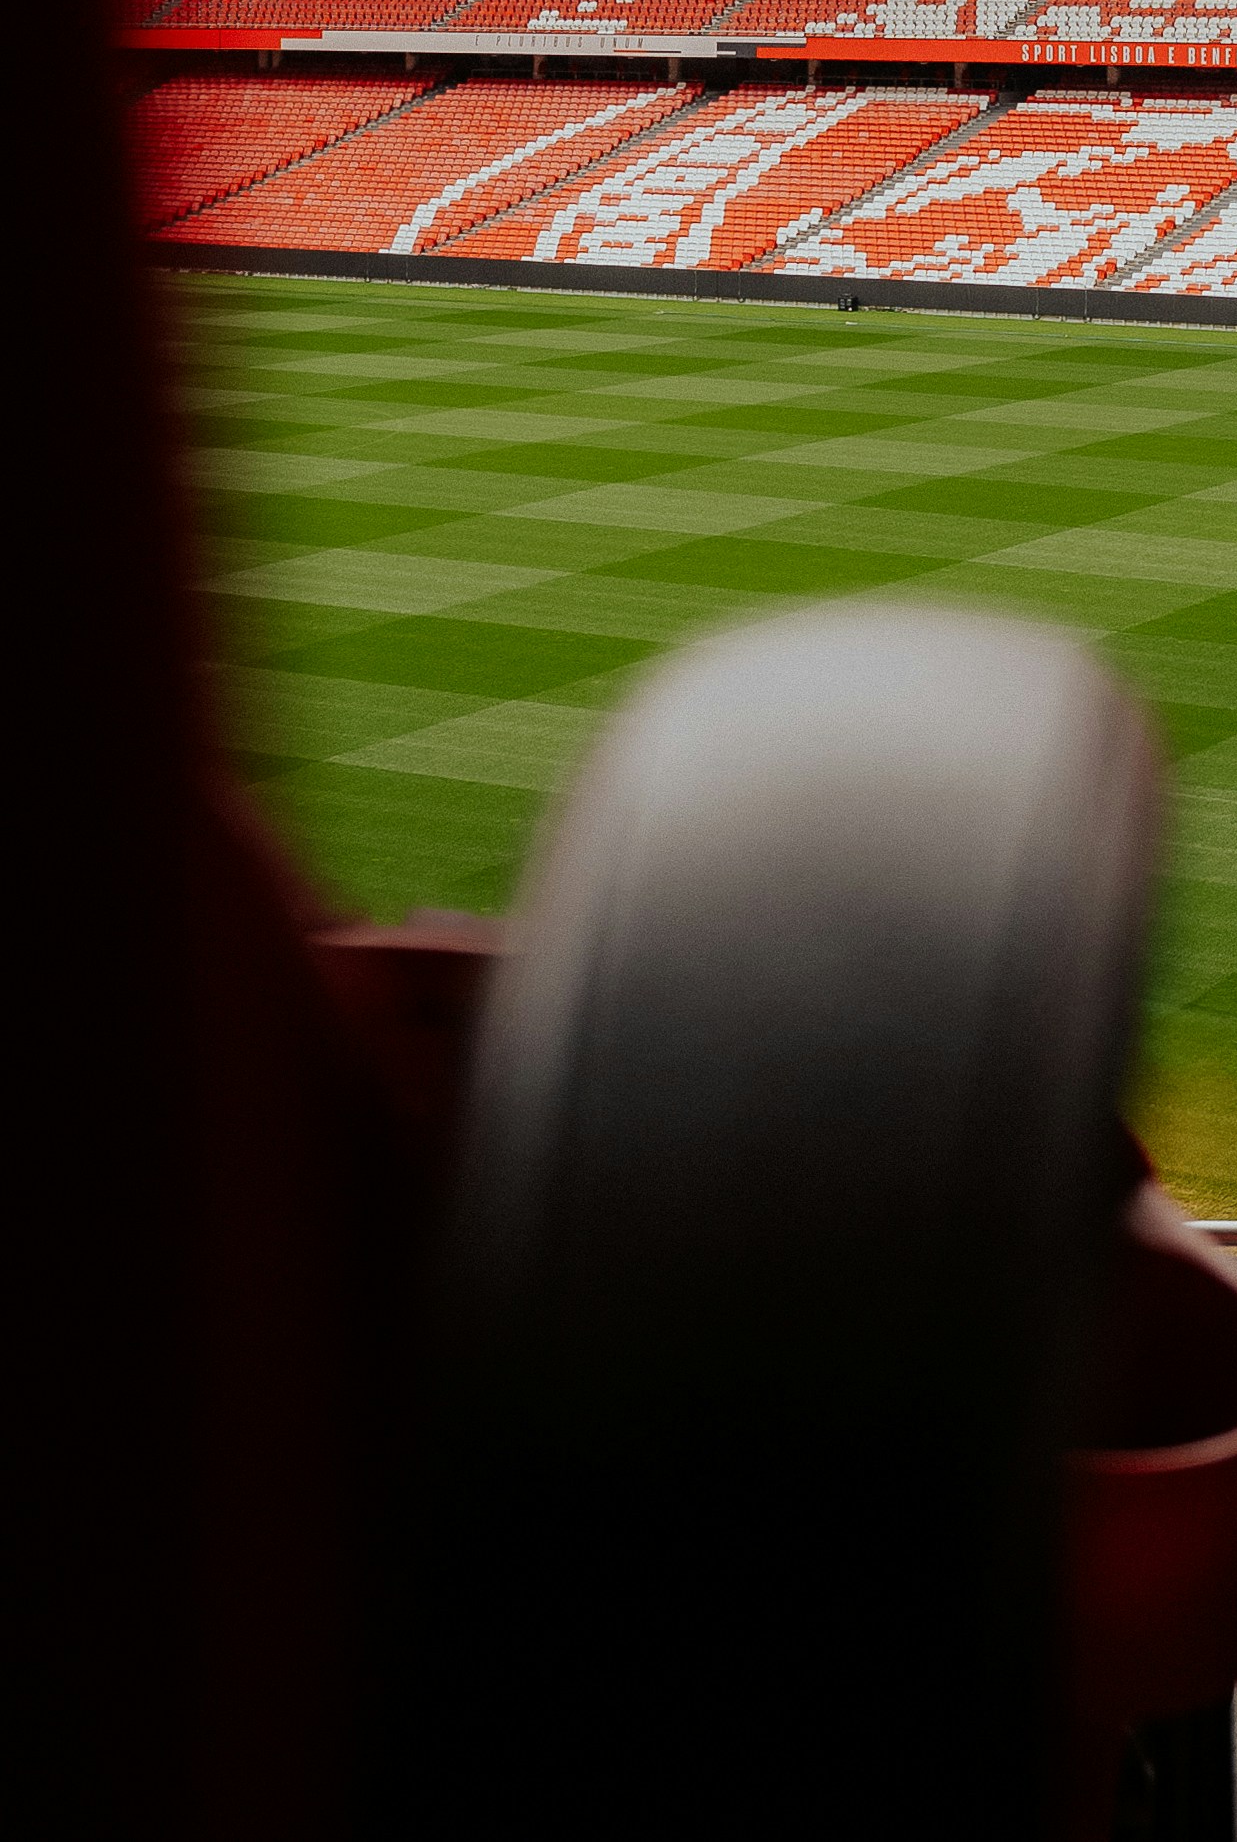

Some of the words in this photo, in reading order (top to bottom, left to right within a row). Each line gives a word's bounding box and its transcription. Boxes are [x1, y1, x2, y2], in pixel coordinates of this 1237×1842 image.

[495, 35, 583, 47] PLURIBUS
[1021, 44, 1078, 63] SPORT
[1089, 45, 1156, 64] LISBOA
[1168, 47, 1175, 64] E
